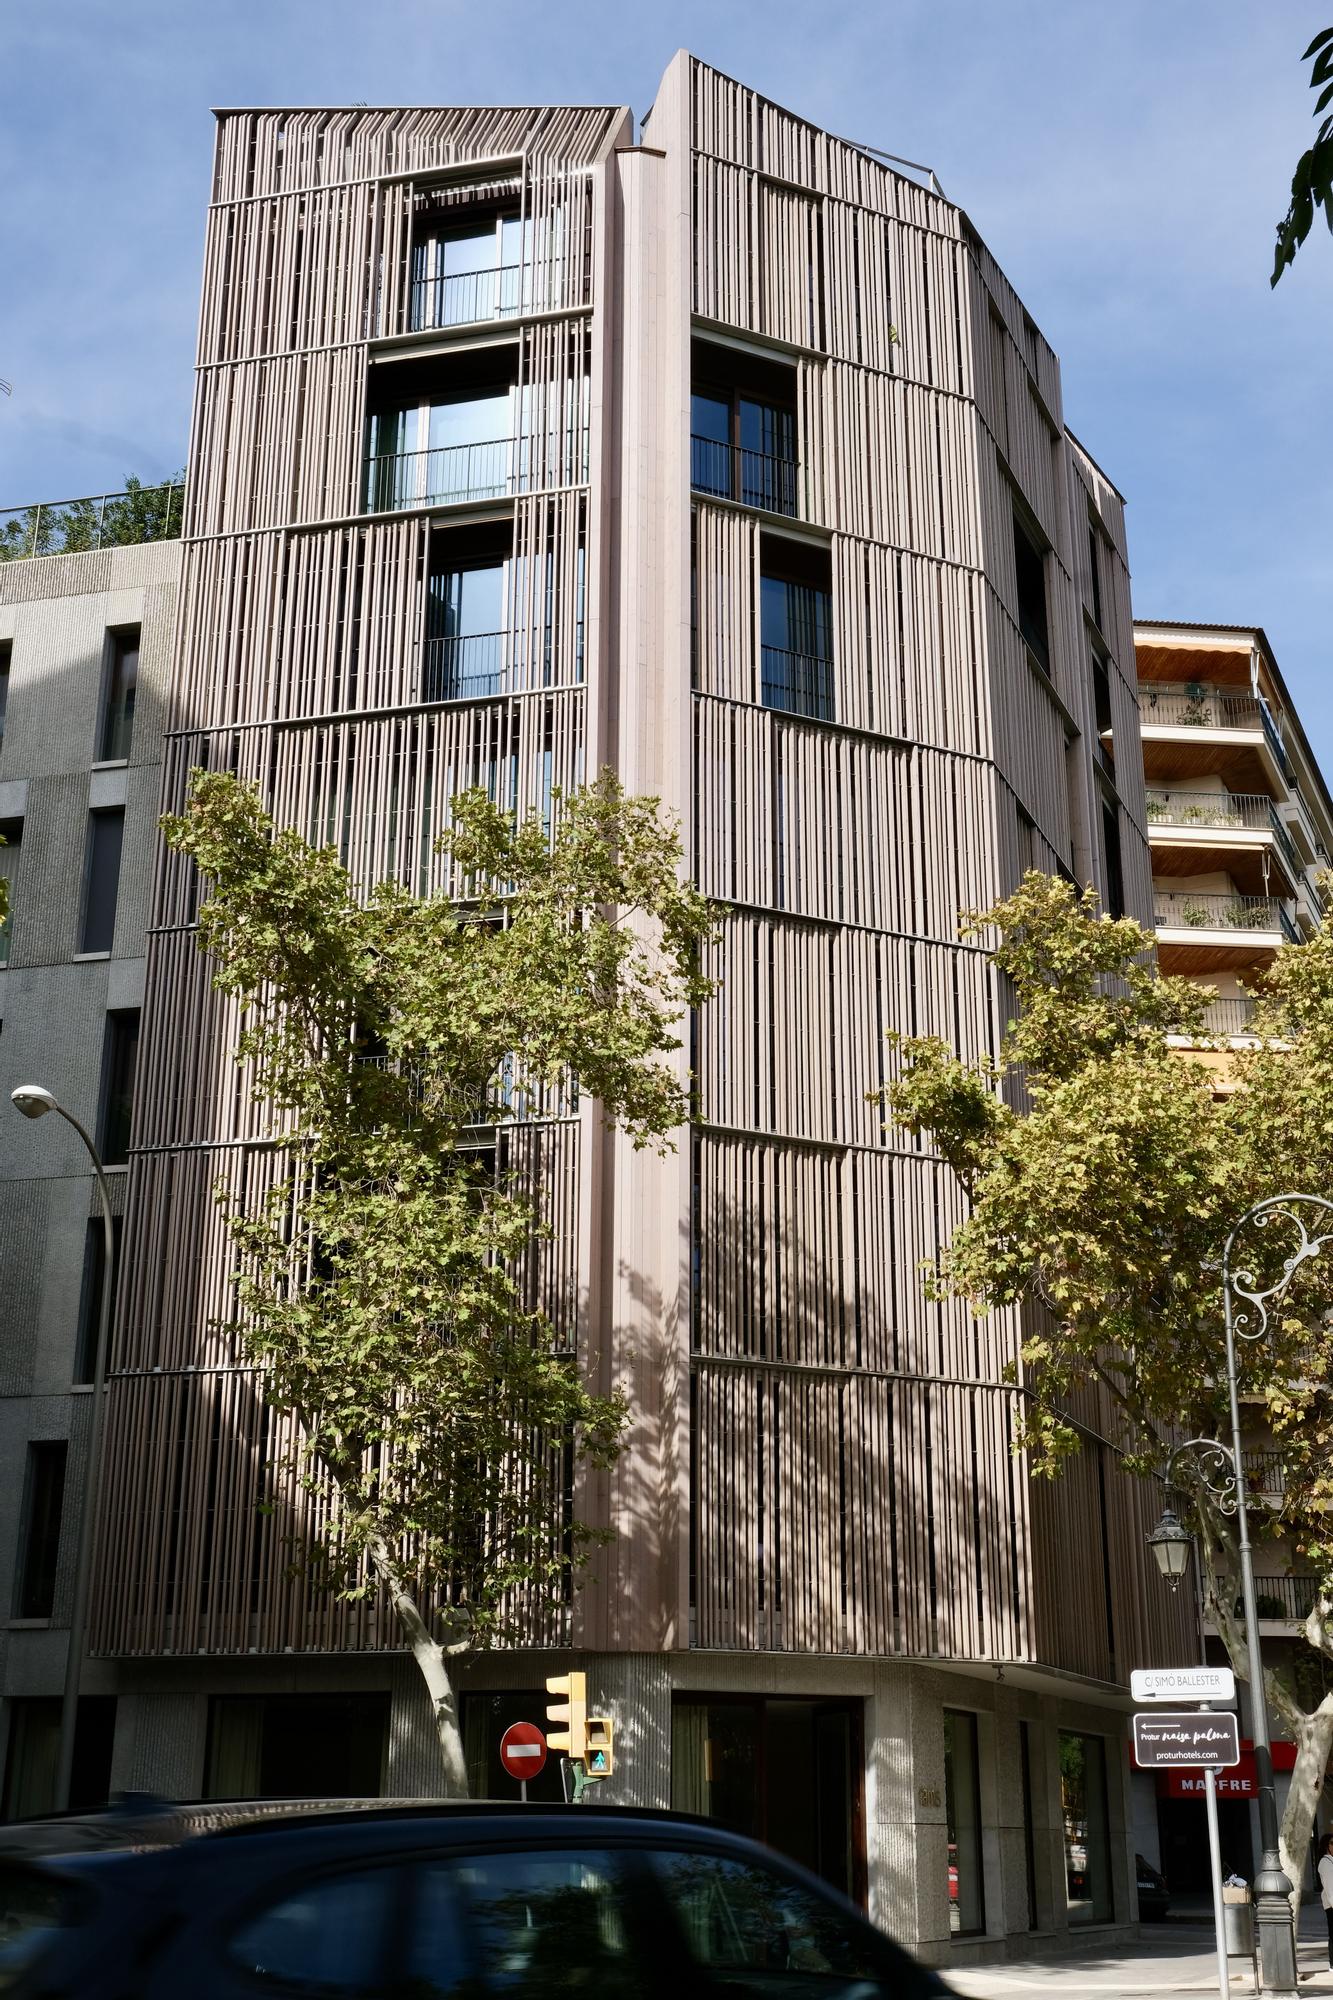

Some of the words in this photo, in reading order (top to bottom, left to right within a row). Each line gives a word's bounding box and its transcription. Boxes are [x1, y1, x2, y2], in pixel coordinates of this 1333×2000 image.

[1144, 1676, 1153, 1688] C/
[1177, 1675, 1220, 1686] BALLESTER
[1141, 1733, 1160, 1741] Protur
[1193, 1728, 1231, 1745] palma
[1156, 1751, 1218, 1760] proturhotels.com
